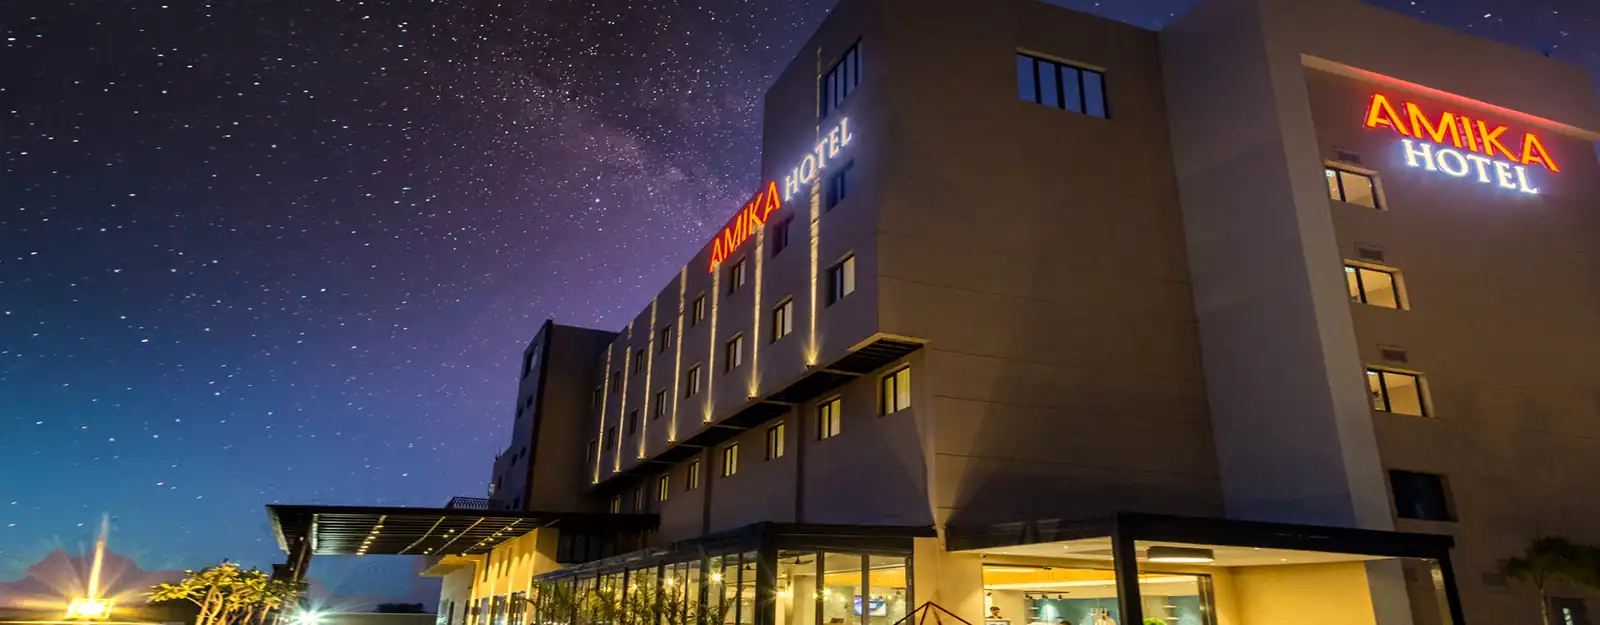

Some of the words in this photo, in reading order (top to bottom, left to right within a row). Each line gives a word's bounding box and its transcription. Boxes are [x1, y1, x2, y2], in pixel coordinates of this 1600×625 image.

[1365, 93, 1560, 172] AMIKA
[1401, 139, 1538, 194] HOTEL
[709, 180, 781, 274] AMIKA
[785, 117, 852, 202] HOTEL
